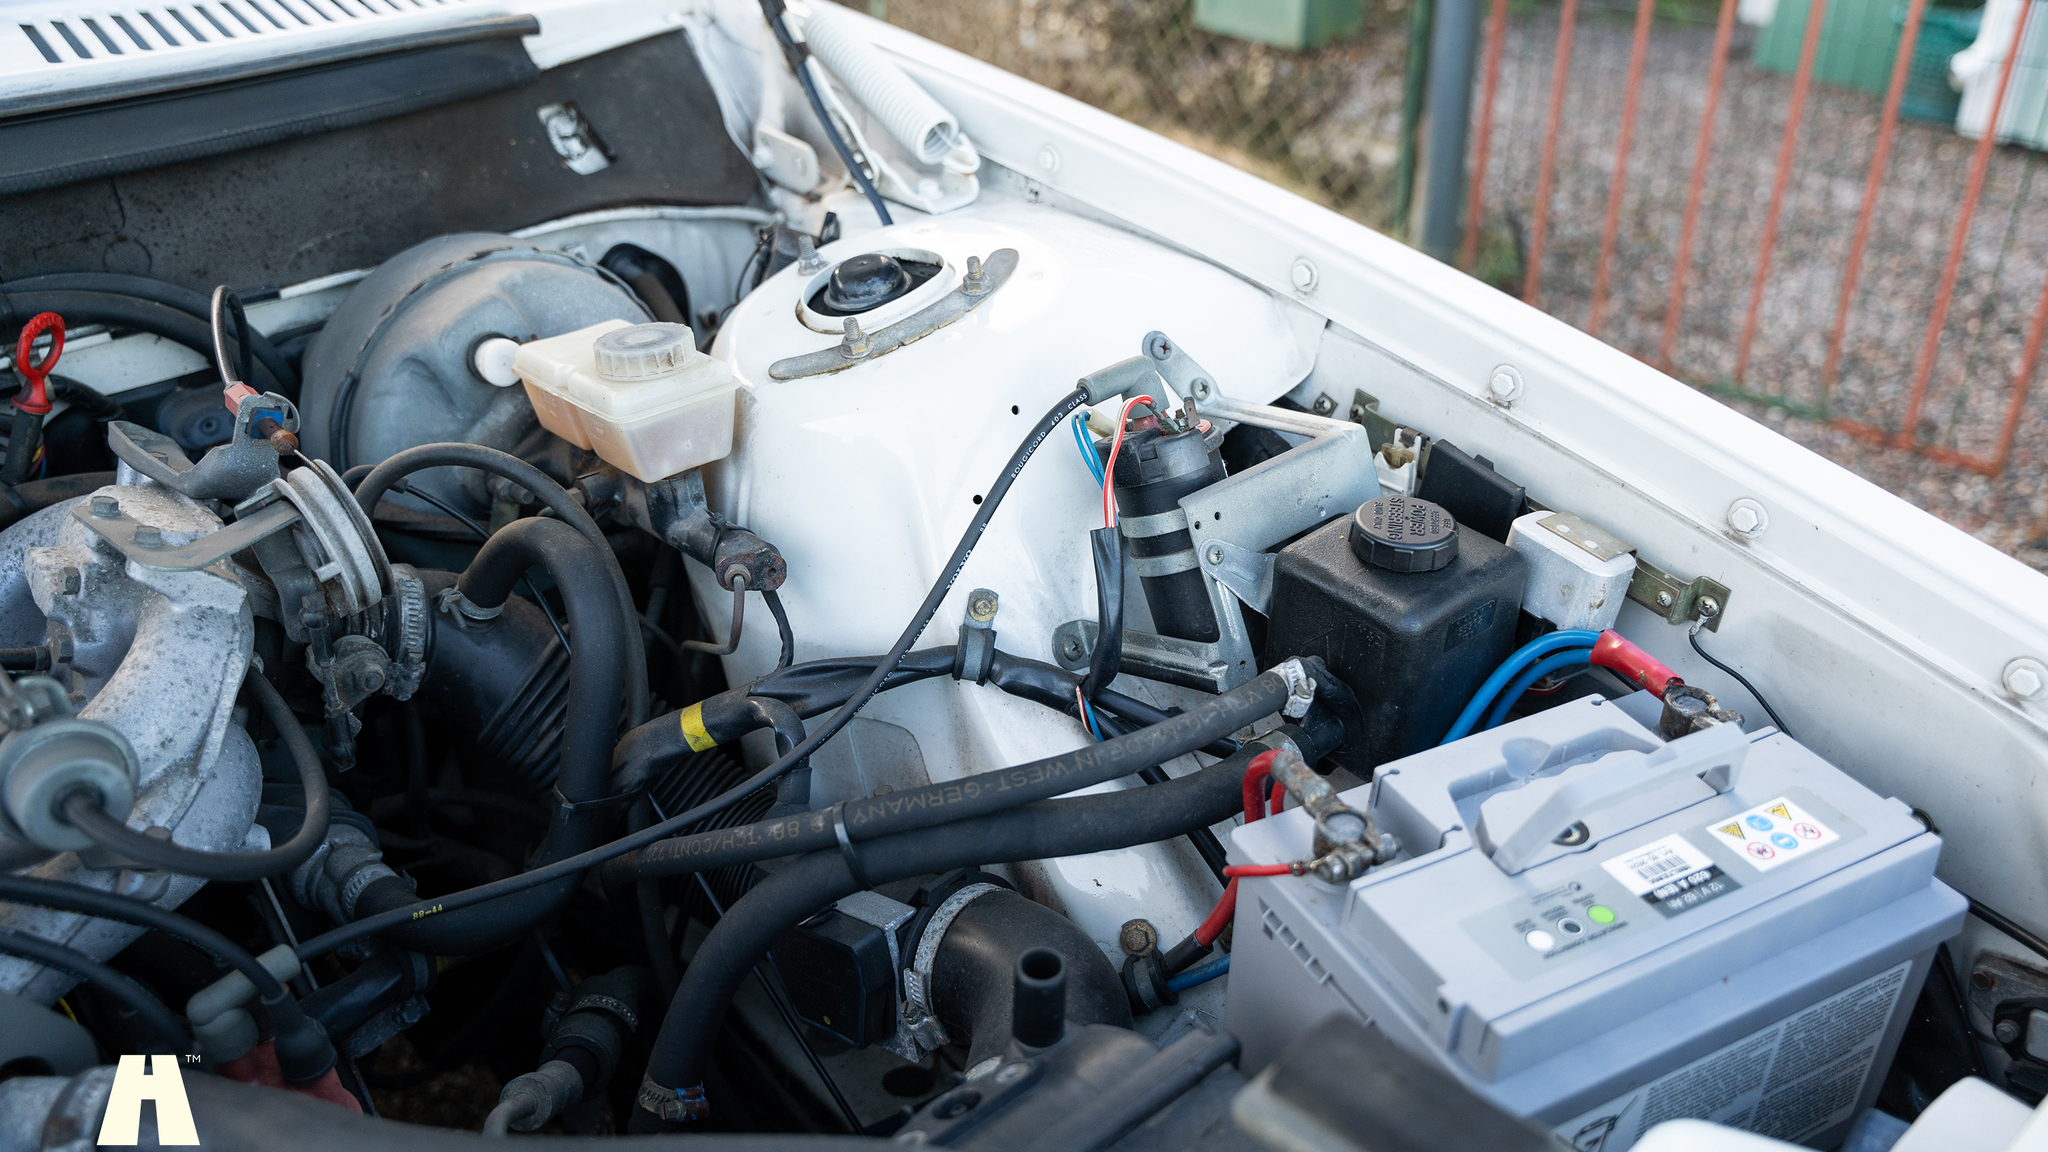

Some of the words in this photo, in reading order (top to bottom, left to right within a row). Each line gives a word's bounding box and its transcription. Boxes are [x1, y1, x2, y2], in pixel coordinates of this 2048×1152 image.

[1010, 431, 1046, 479] BOUGICORD
[1050, 412, 1064, 426] 403
[1067, 392, 1088, 410] CLASS
[1386, 497, 1404, 541] STEERING
[1409, 504, 1426, 537] POWER
[852, 761, 1071, 825] WEST-GERMANY
[1688, 870, 1712, 885] 620
